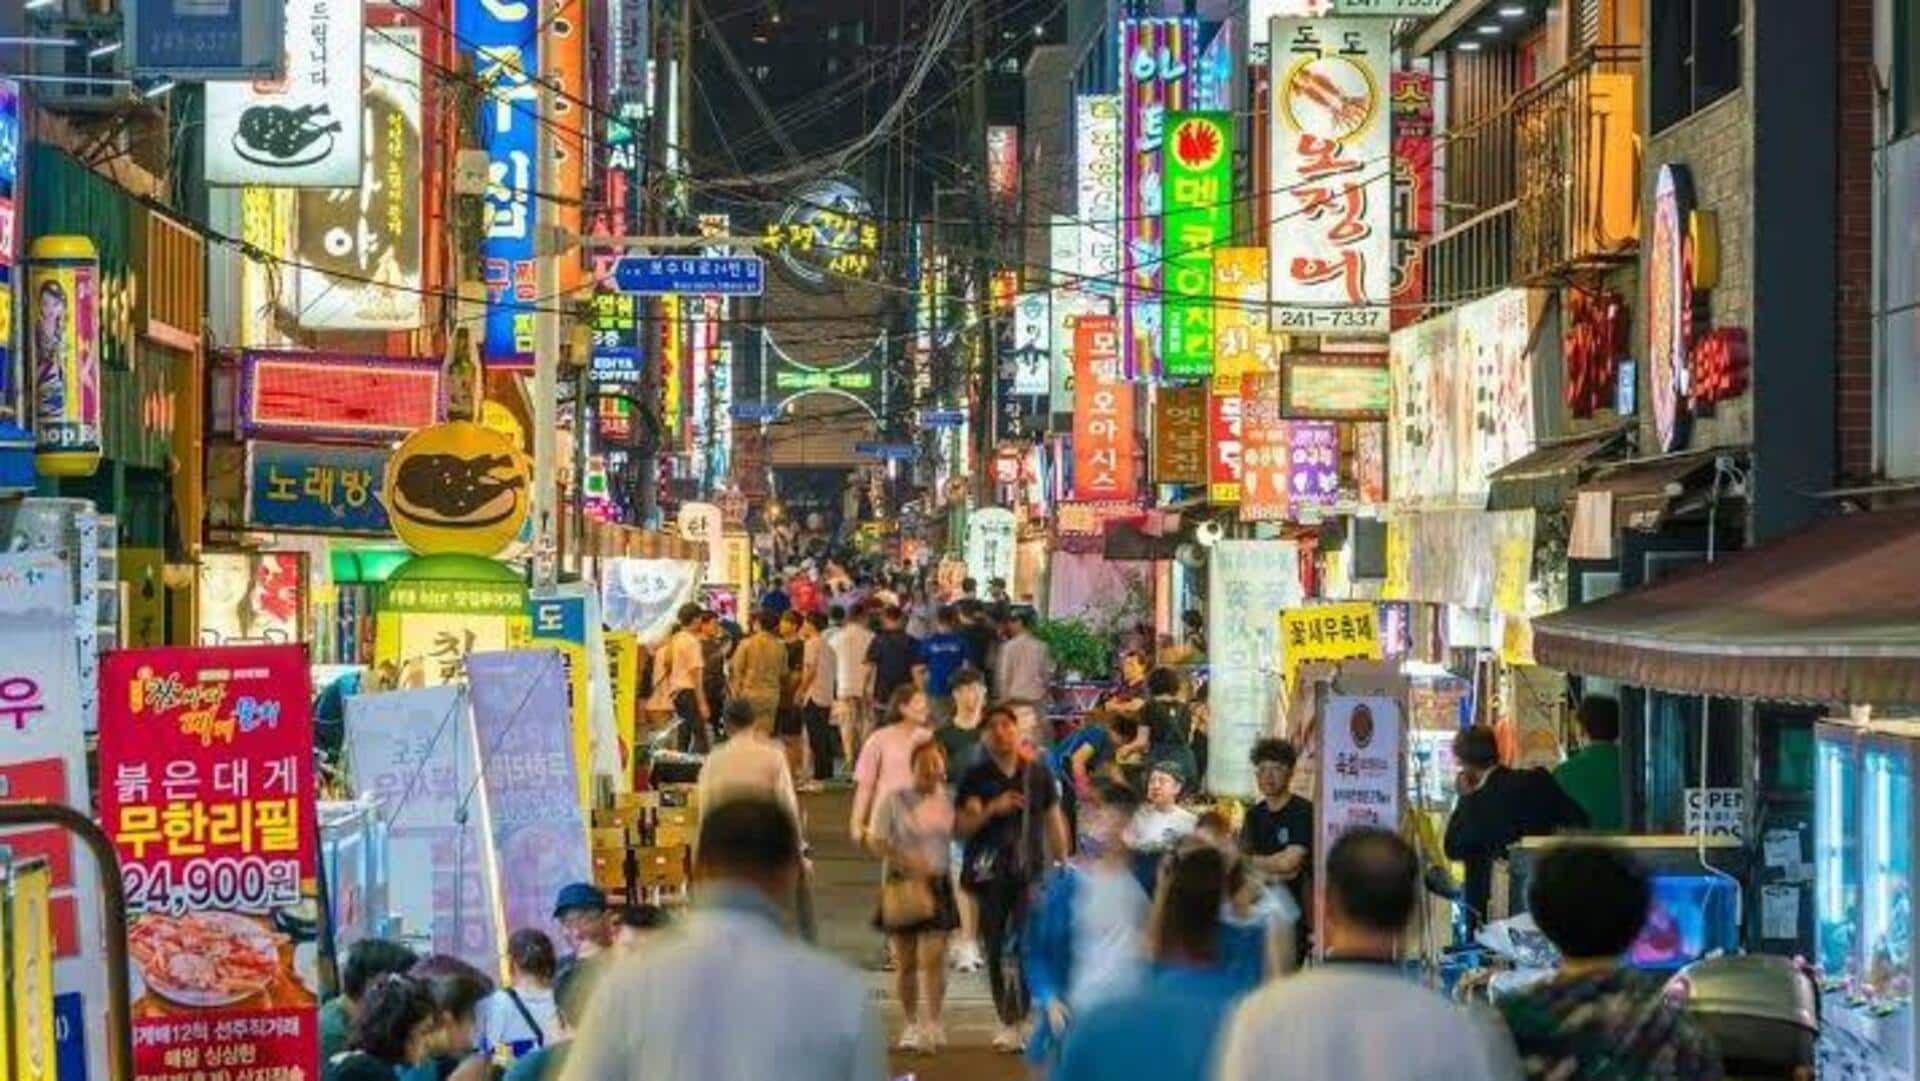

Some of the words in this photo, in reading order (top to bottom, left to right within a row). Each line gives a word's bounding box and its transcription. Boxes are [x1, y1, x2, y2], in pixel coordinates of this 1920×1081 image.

[1290, 25, 1367, 60] 독도
[1281, 311, 1380, 328] 241-7337
[588, 370, 641, 381] COFFEE
[1087, 331, 1121, 492] 모텔오아시스
[267, 464, 372, 507] 노래방
[537, 603, 565, 631] 도
[1290, 614, 1372, 647] 꽃새우축제
[115, 797, 300, 858] 무한리필
[122, 855, 301, 917] 24,900원
